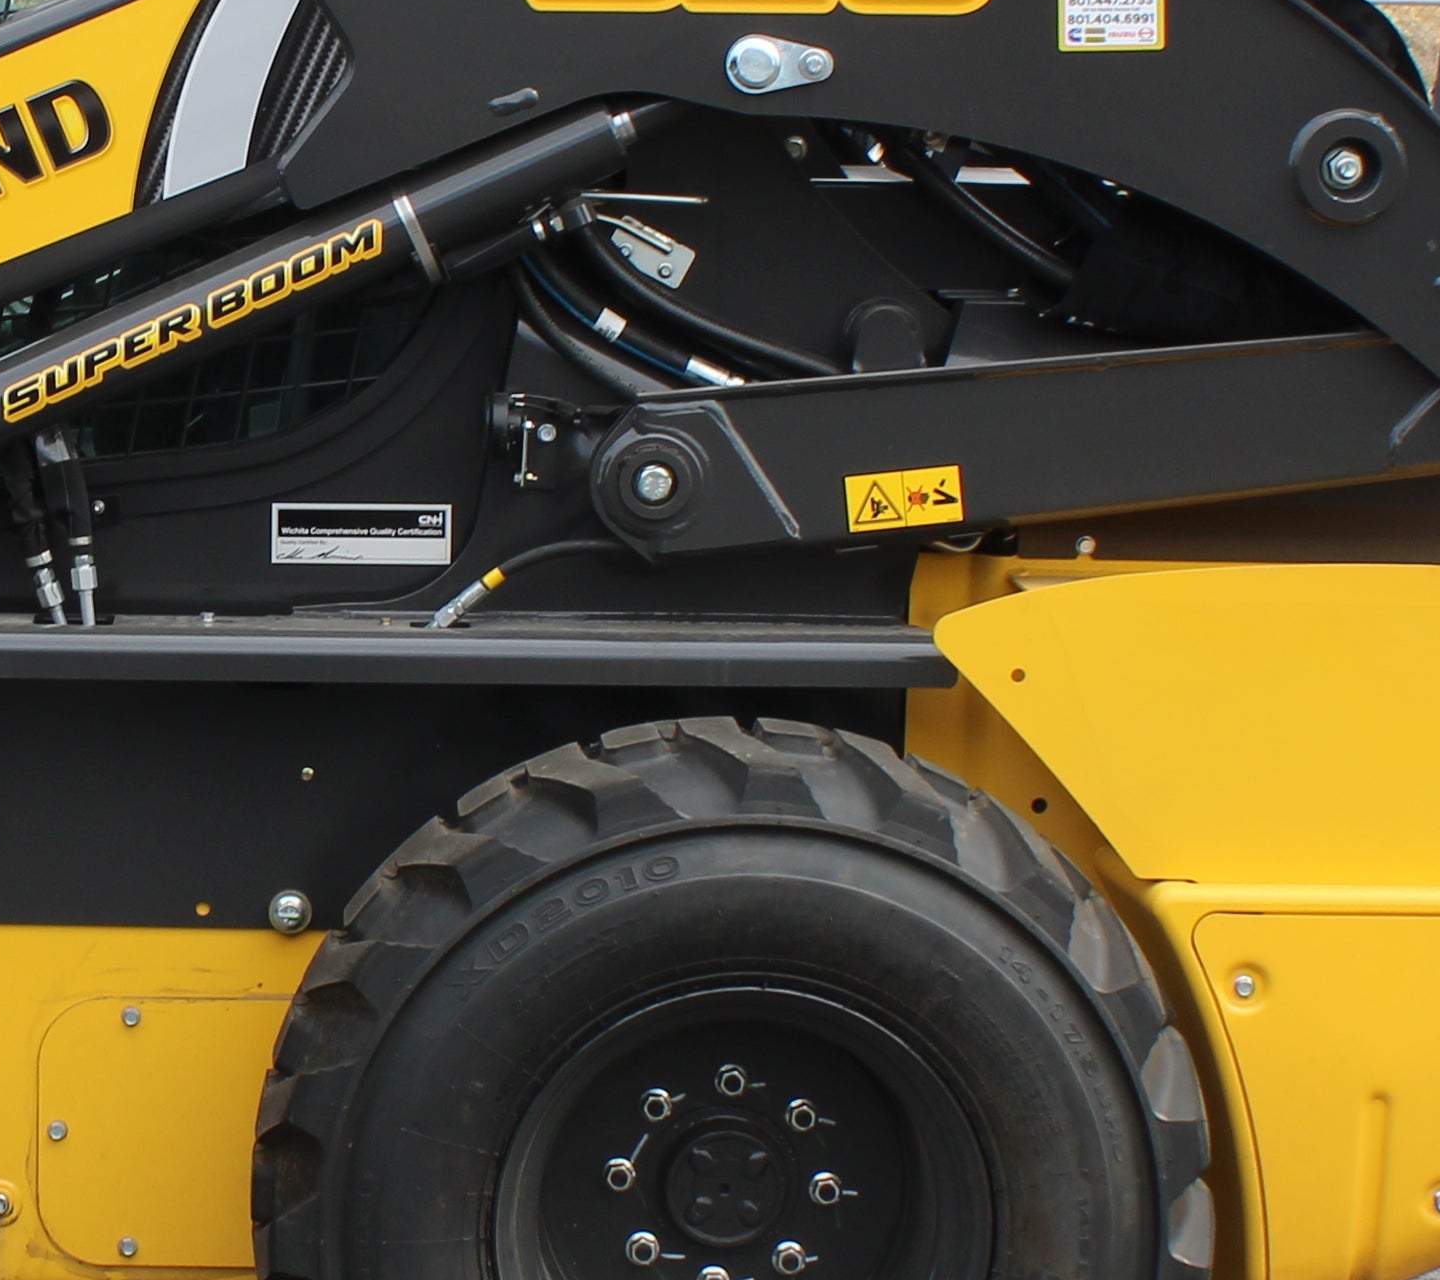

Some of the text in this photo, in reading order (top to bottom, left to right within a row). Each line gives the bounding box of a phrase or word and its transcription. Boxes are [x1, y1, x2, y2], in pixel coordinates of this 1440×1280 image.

[1067, 13, 1155, 24] 801.404.6991
[3, 219, 382, 420] SUPER BOOM
[281, 526, 442, 537] Wichita Comprehensive Quality Certification
[445, 855, 681, 996] XD2010
